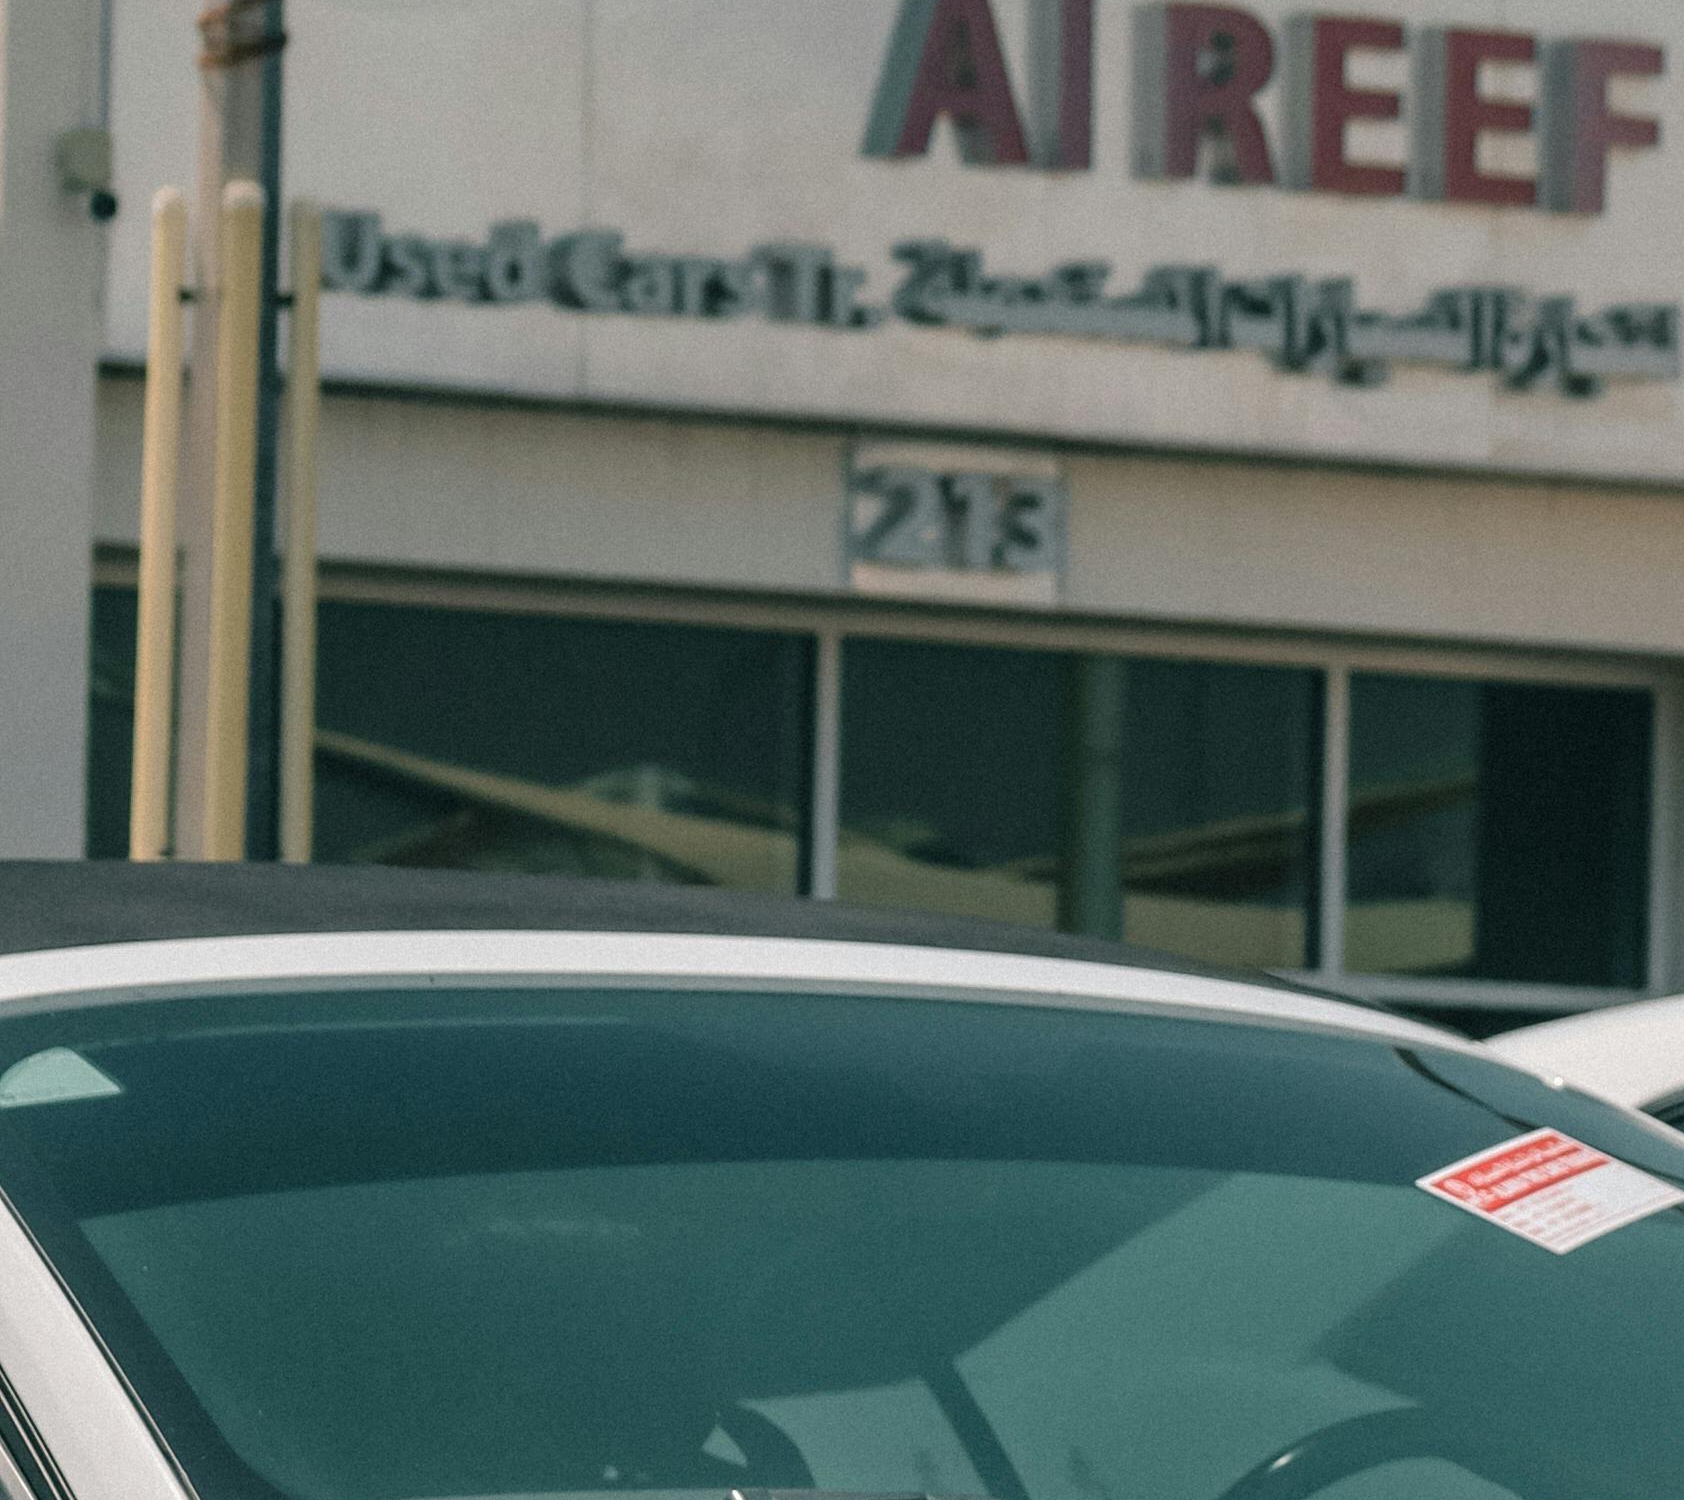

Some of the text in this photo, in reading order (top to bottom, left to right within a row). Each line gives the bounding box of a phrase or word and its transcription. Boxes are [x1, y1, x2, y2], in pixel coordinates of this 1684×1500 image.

[1130, 0, 1664, 215] REEF
[322, 208, 543, 306] Used
[548, 226, 752, 320] Cars
